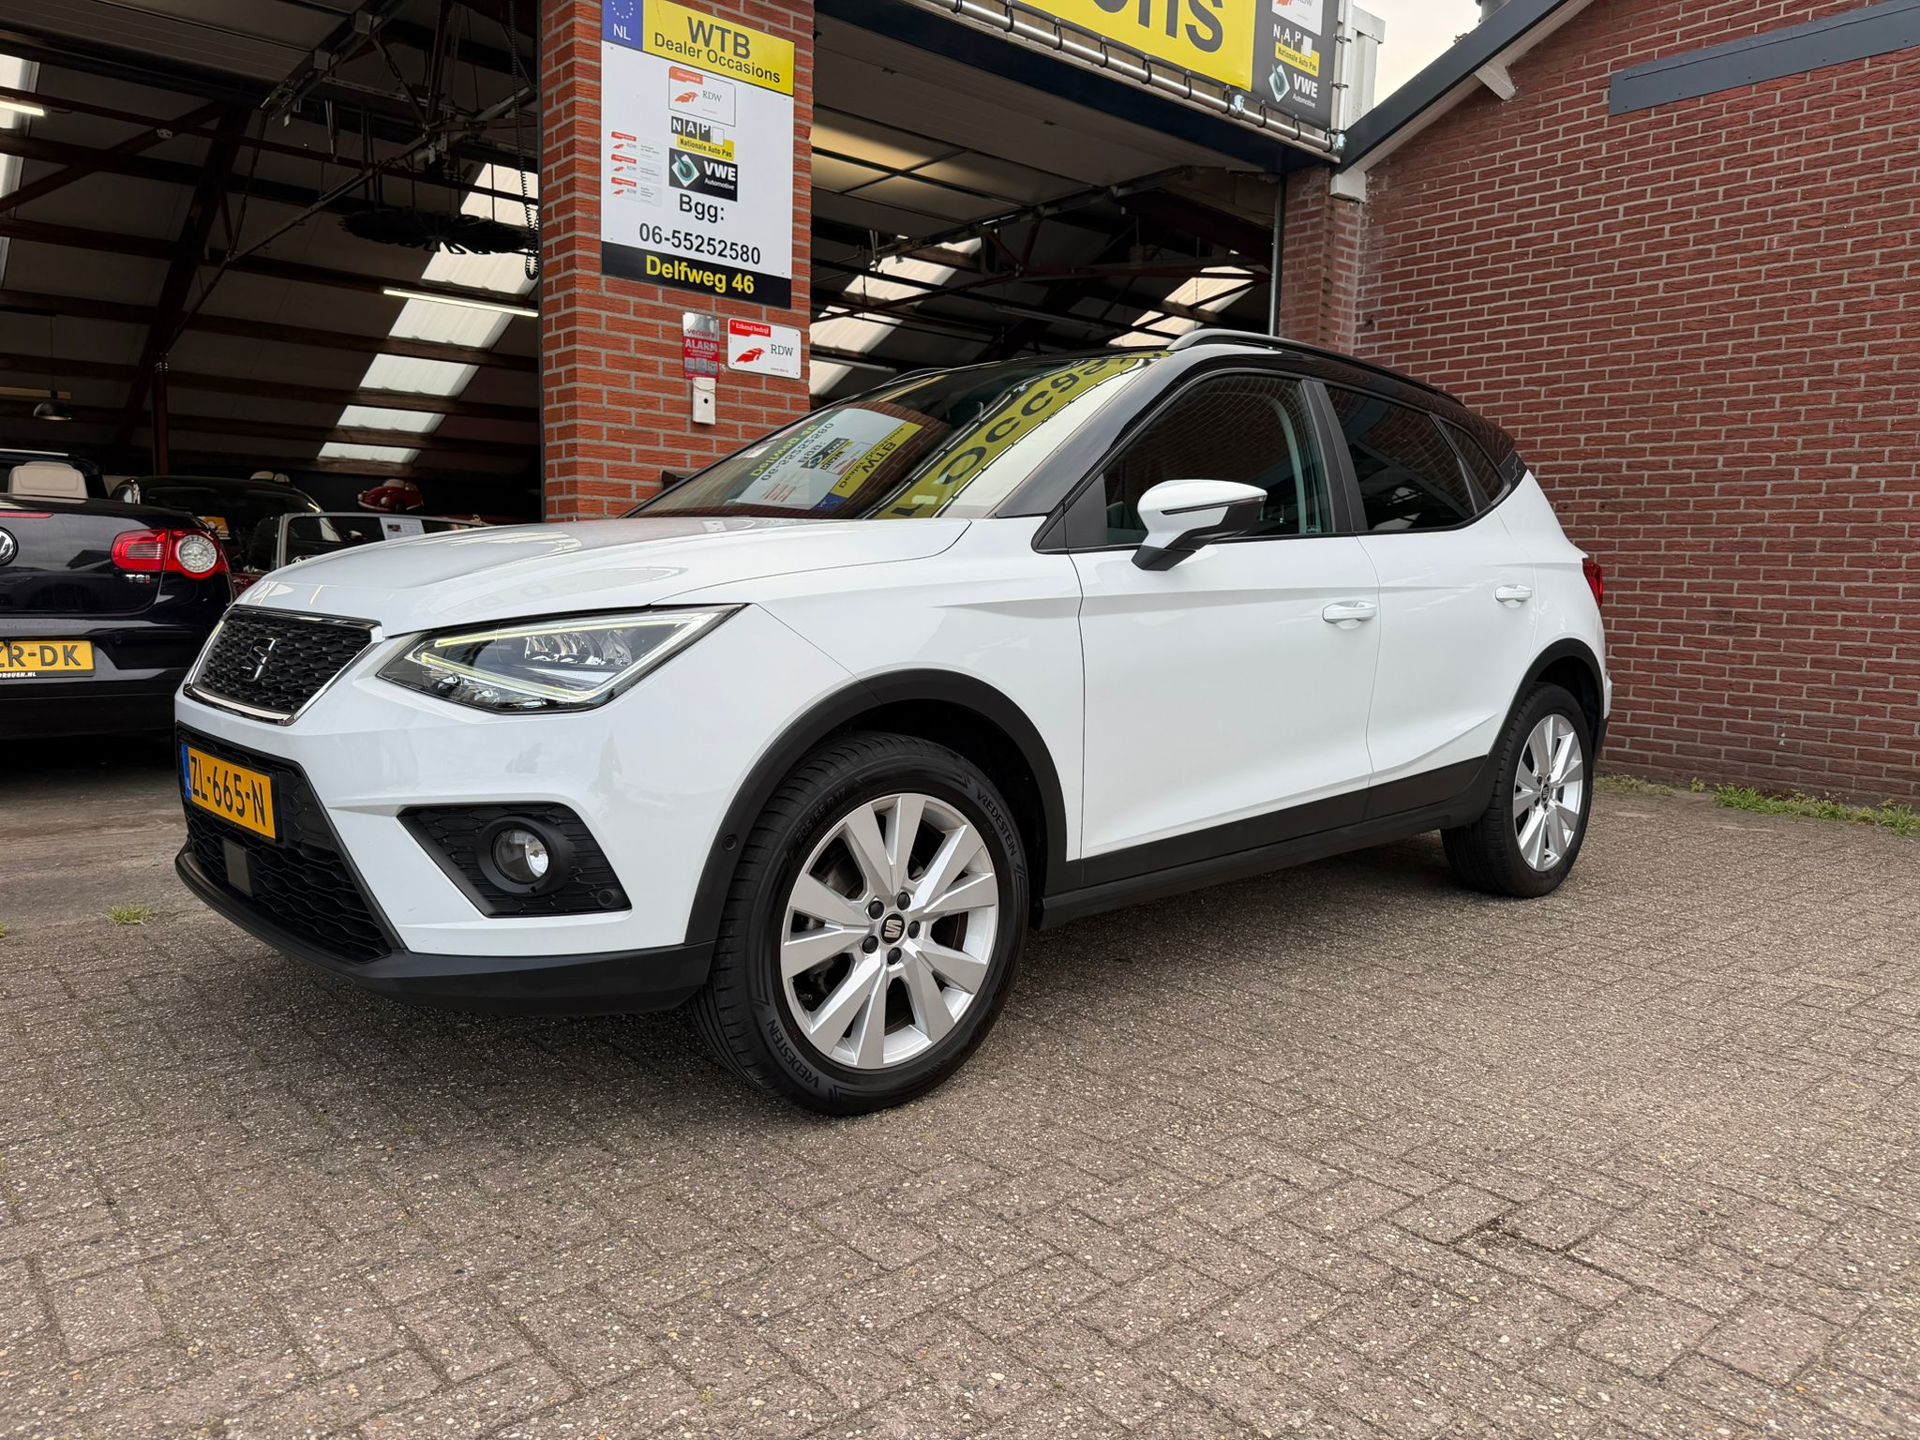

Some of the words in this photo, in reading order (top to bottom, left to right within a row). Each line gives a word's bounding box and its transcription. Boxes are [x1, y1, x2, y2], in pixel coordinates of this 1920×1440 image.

[613, 23, 632, 41] NL
[687, 16, 751, 60] WTB
[654, 32, 703, 59] Dealer
[707, 50, 781, 84] Occasions
[702, 90, 722, 103] RDW
[1293, 72, 1318, 98] VWE
[680, 138, 707, 152] Nationale
[708, 145, 721, 155] Auto
[721, 149, 733, 158] Pas
[703, 160, 737, 181] VWE
[704, 178, 735, 190] Automotive
[679, 193, 725, 223] Bgg:
[639, 222, 761, 265] 06-55252580
[646, 255, 727, 293] Delfweg
[731, 273, 755, 294] 46
[685, 338, 718, 352] ALARM
[770, 344, 794, 357] RDW
[190, 754, 267, 828] ZL-665-N
[976, 788, 1018, 857] VREDESTEIN
[766, 1019, 820, 1089] VREDESTEIN
